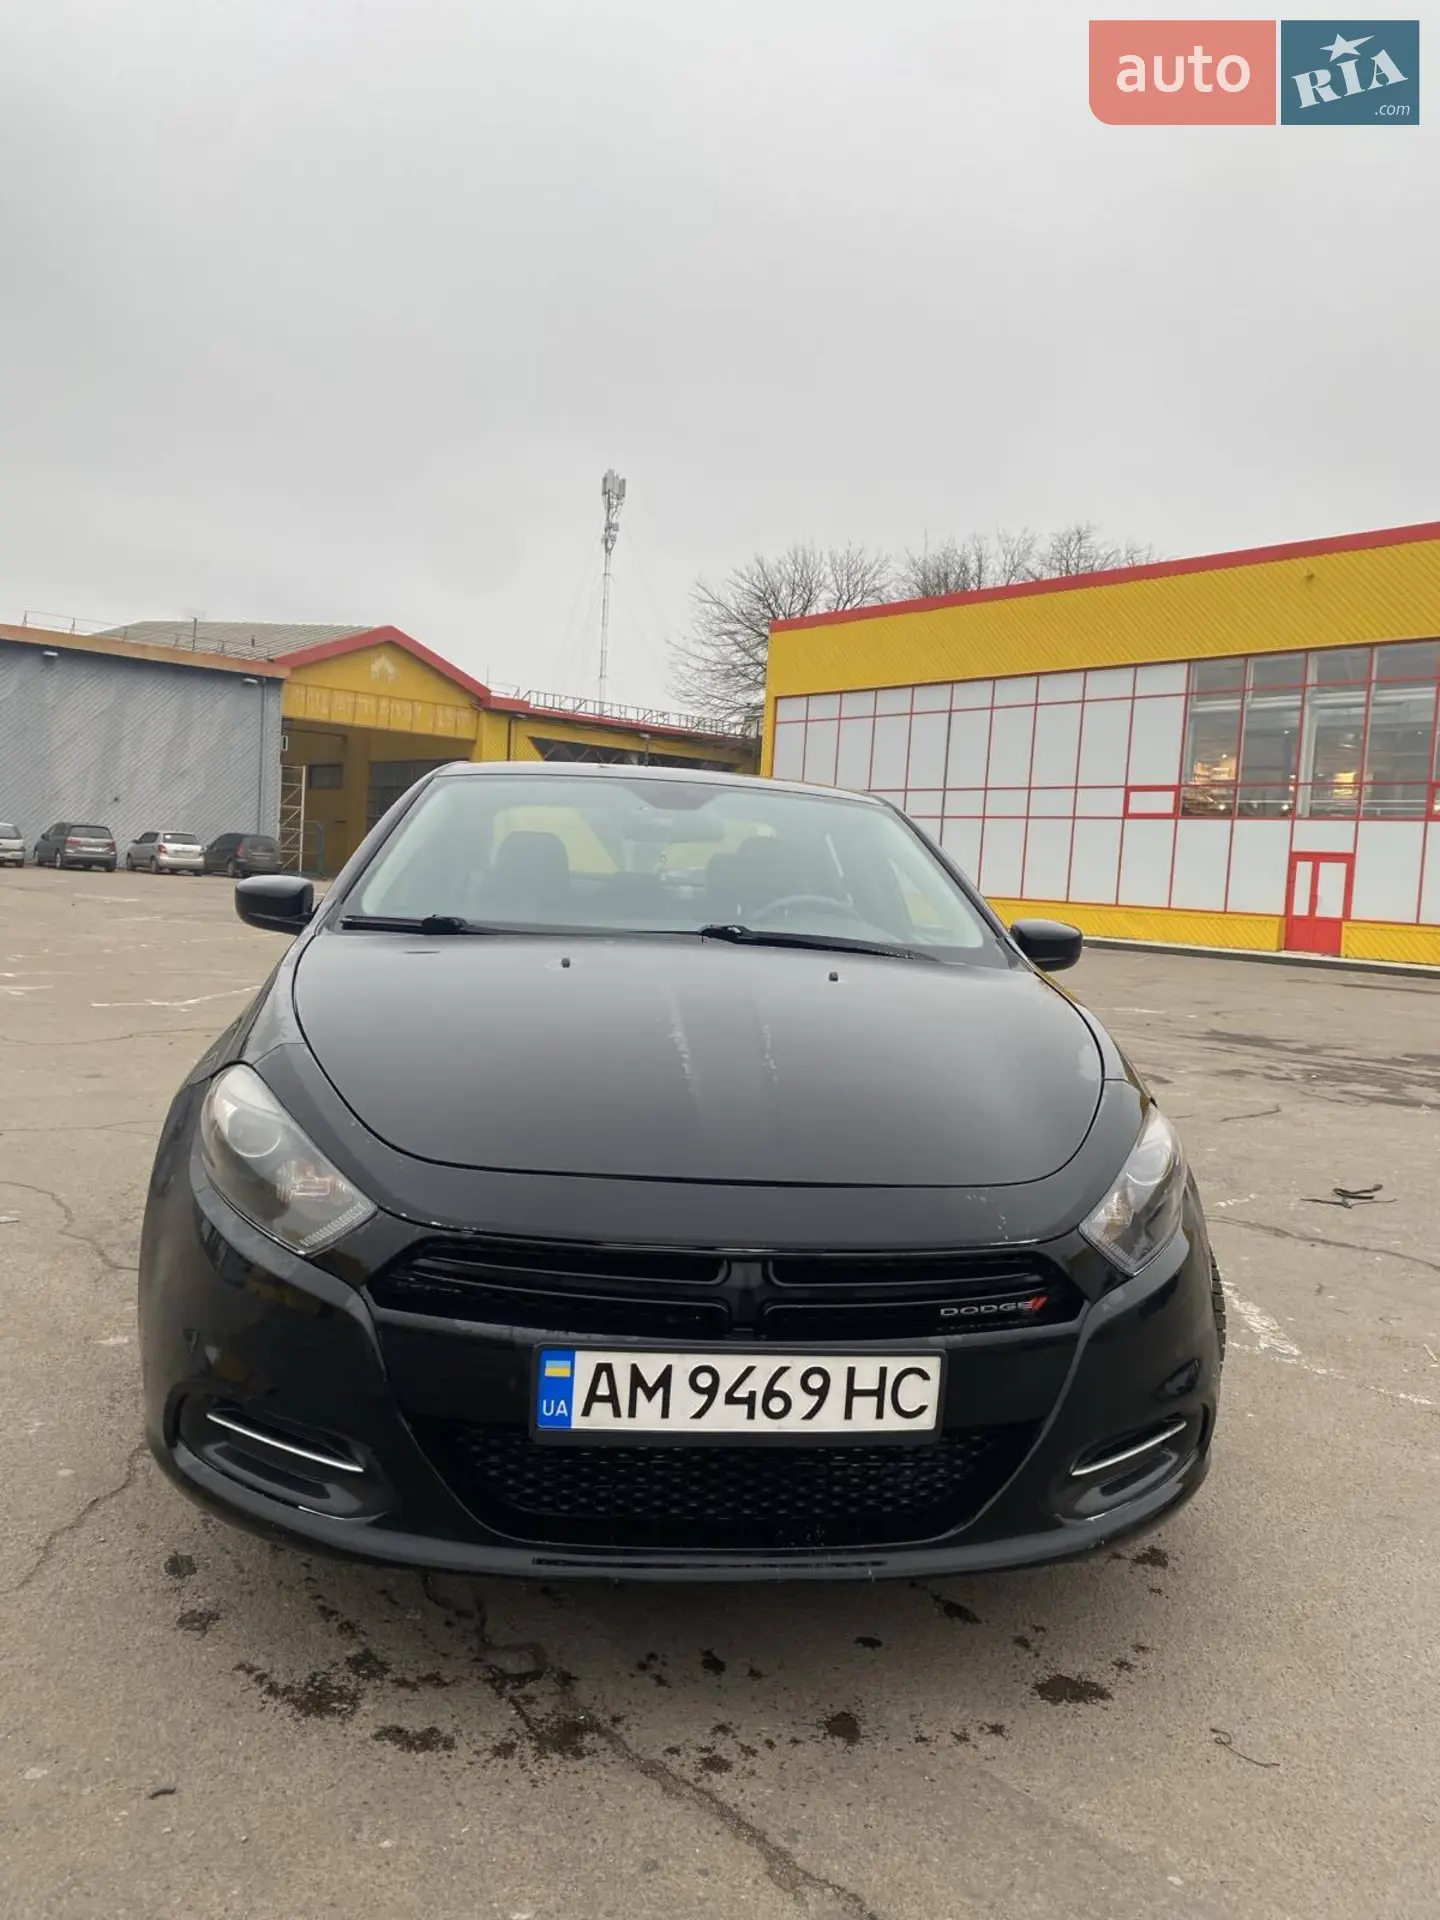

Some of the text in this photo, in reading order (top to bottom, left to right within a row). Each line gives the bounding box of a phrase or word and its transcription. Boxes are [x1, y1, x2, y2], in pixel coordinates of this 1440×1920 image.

[940, 1301, 1033, 1316] DODGE
[580, 1362, 932, 1421] AM 9469 HC
[542, 1399, 569, 1417] UA
